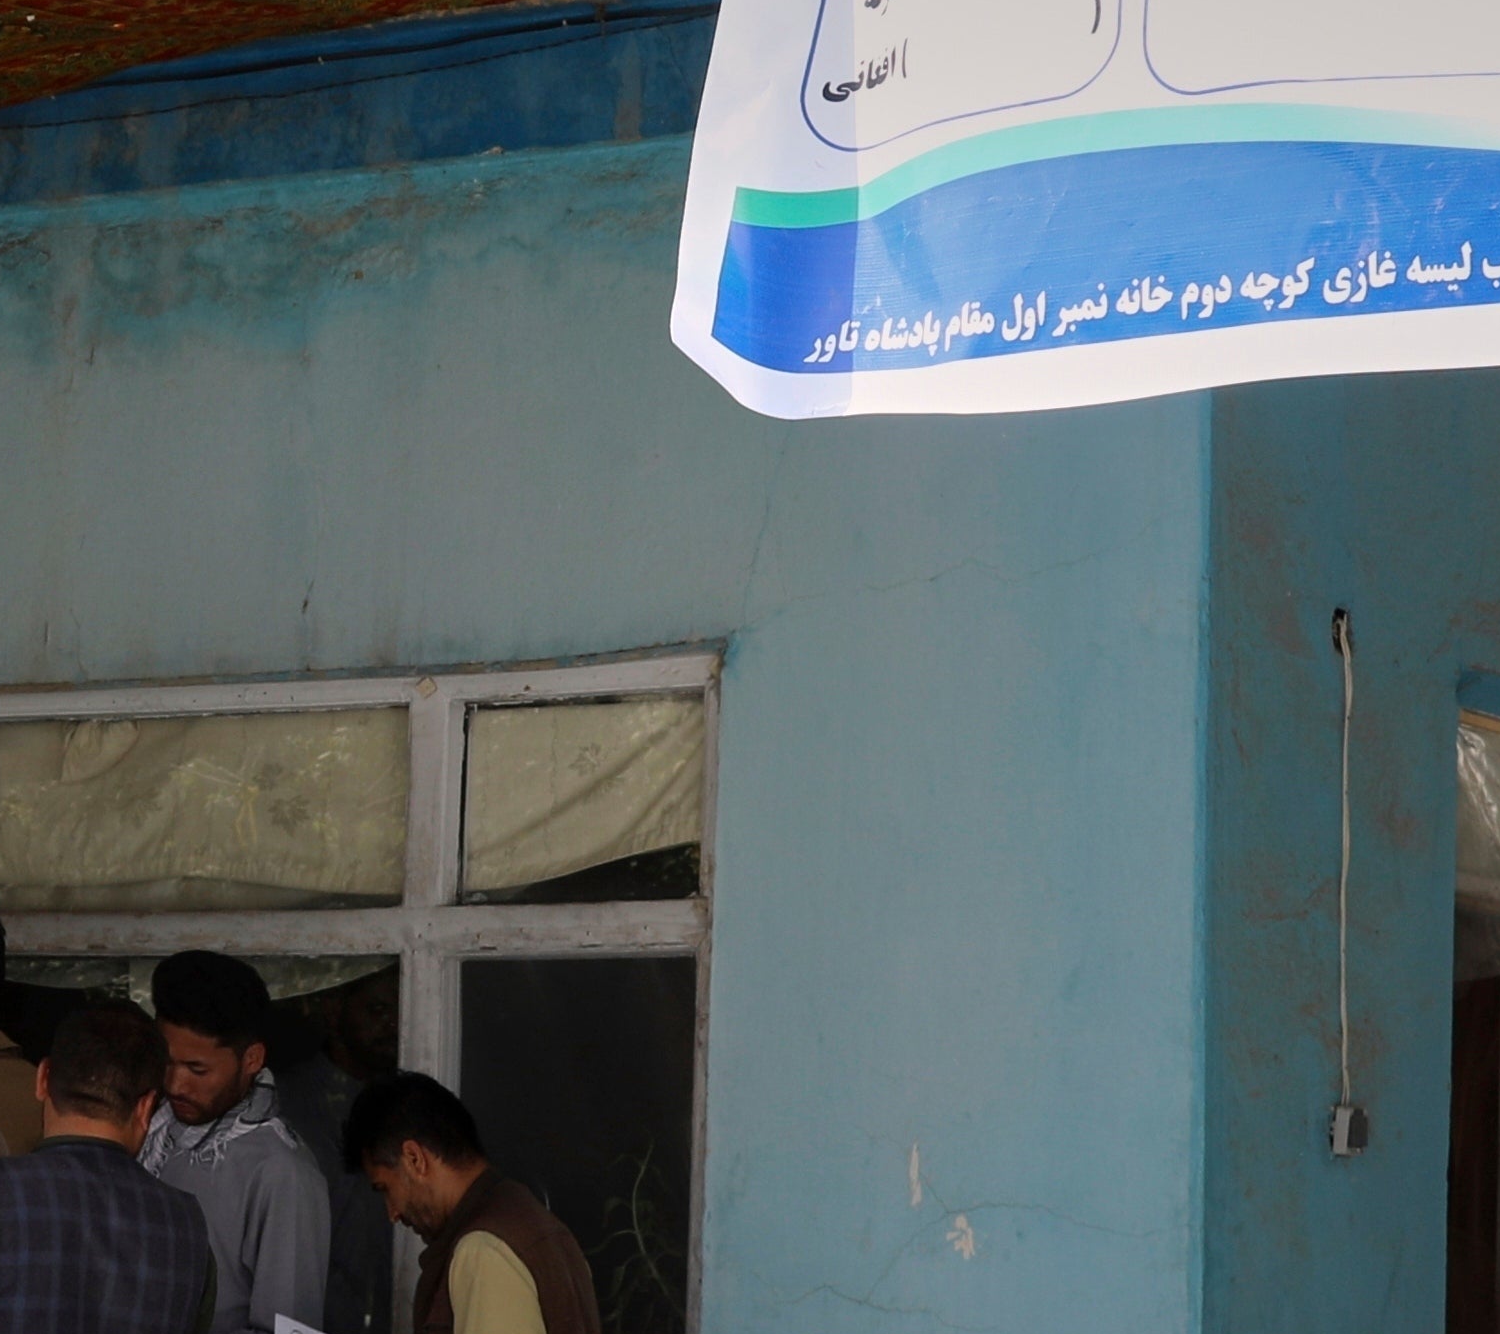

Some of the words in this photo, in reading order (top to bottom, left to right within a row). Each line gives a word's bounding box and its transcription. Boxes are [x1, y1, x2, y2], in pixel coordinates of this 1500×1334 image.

[822, 47, 897, 102] افغانی
[1239, 257, 1314, 310] کوچه
[1322, 249, 1398, 305] غازی
[1405, 241, 1473, 292] لیسه
[1001, 290, 1047, 341] اول
[1052, 282, 1109, 338] نمبر
[1115, 274, 1173, 315] خانه
[1181, 273, 1233, 319] دوم
[803, 319, 859, 365] تاور
[864, 310, 941, 357] پادشاه
[944, 301, 995, 353] مقام
